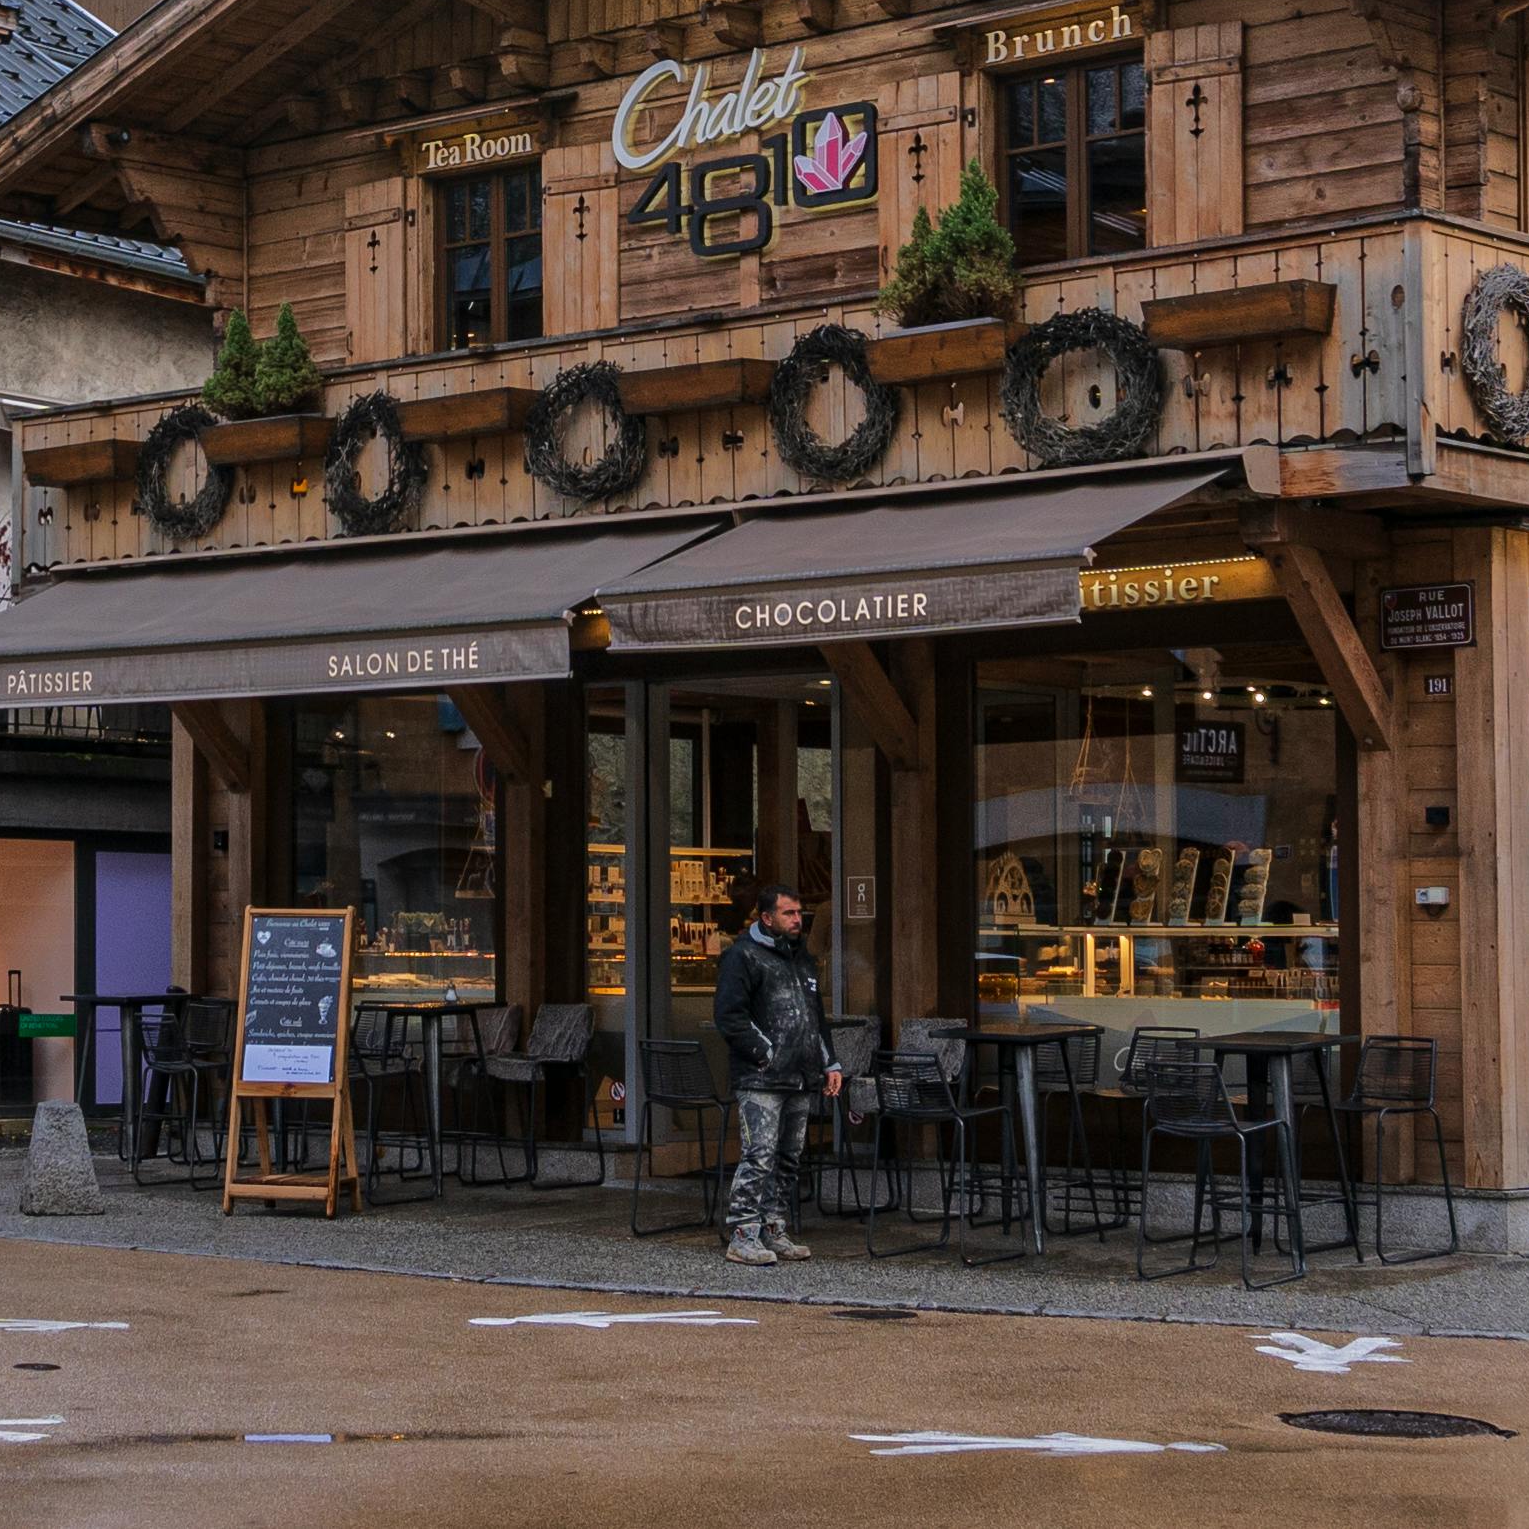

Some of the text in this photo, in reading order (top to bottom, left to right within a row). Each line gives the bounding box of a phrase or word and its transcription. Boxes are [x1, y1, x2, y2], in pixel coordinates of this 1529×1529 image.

[985, 5, 1133, 64] Brunch
[611, 45, 808, 169] Chalet
[421, 133, 533, 169] Tea Room
[627, 100, 879, 257] 4810
[1079, 569, 1219, 607] tissier
[1419, 590, 1445, 602] RUE
[735, 593, 928, 629] CHOCOLATIER
[1388, 604, 1464, 622] JOSEPH VALLOT
[328, 641, 479, 677] SALON DE THÉ
[7, 669, 93, 694] PÂTISSIER
[1428, 678, 1447, 693] 191
